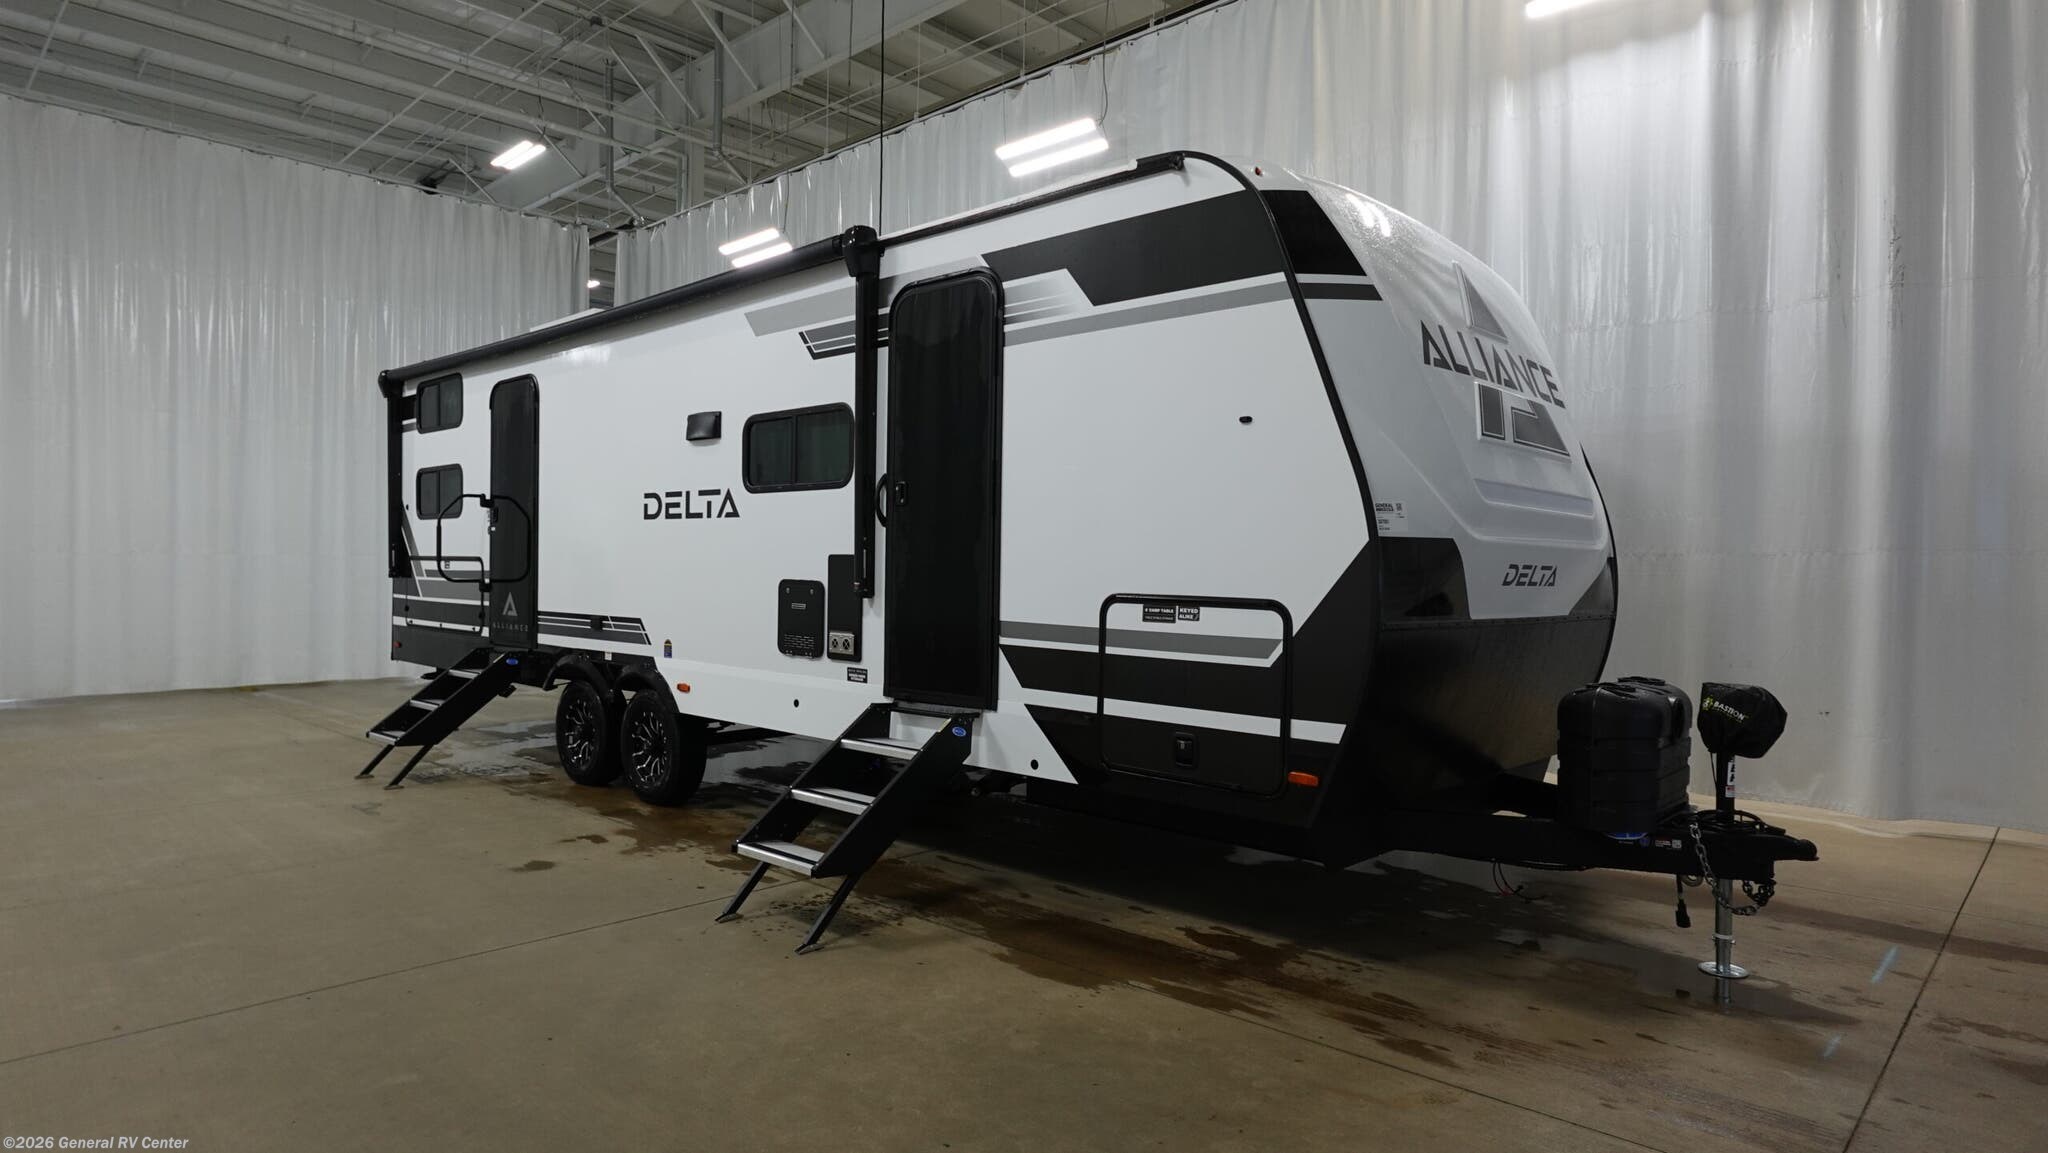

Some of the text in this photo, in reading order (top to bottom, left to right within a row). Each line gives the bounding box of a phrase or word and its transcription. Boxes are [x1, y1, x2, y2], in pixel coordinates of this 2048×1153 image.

[1420, 319, 1566, 409] ALLIANCE
[643, 488, 740, 520] DELTA
[1501, 563, 1557, 587] DELTA
[1713, 700, 1745, 721] BASTION
